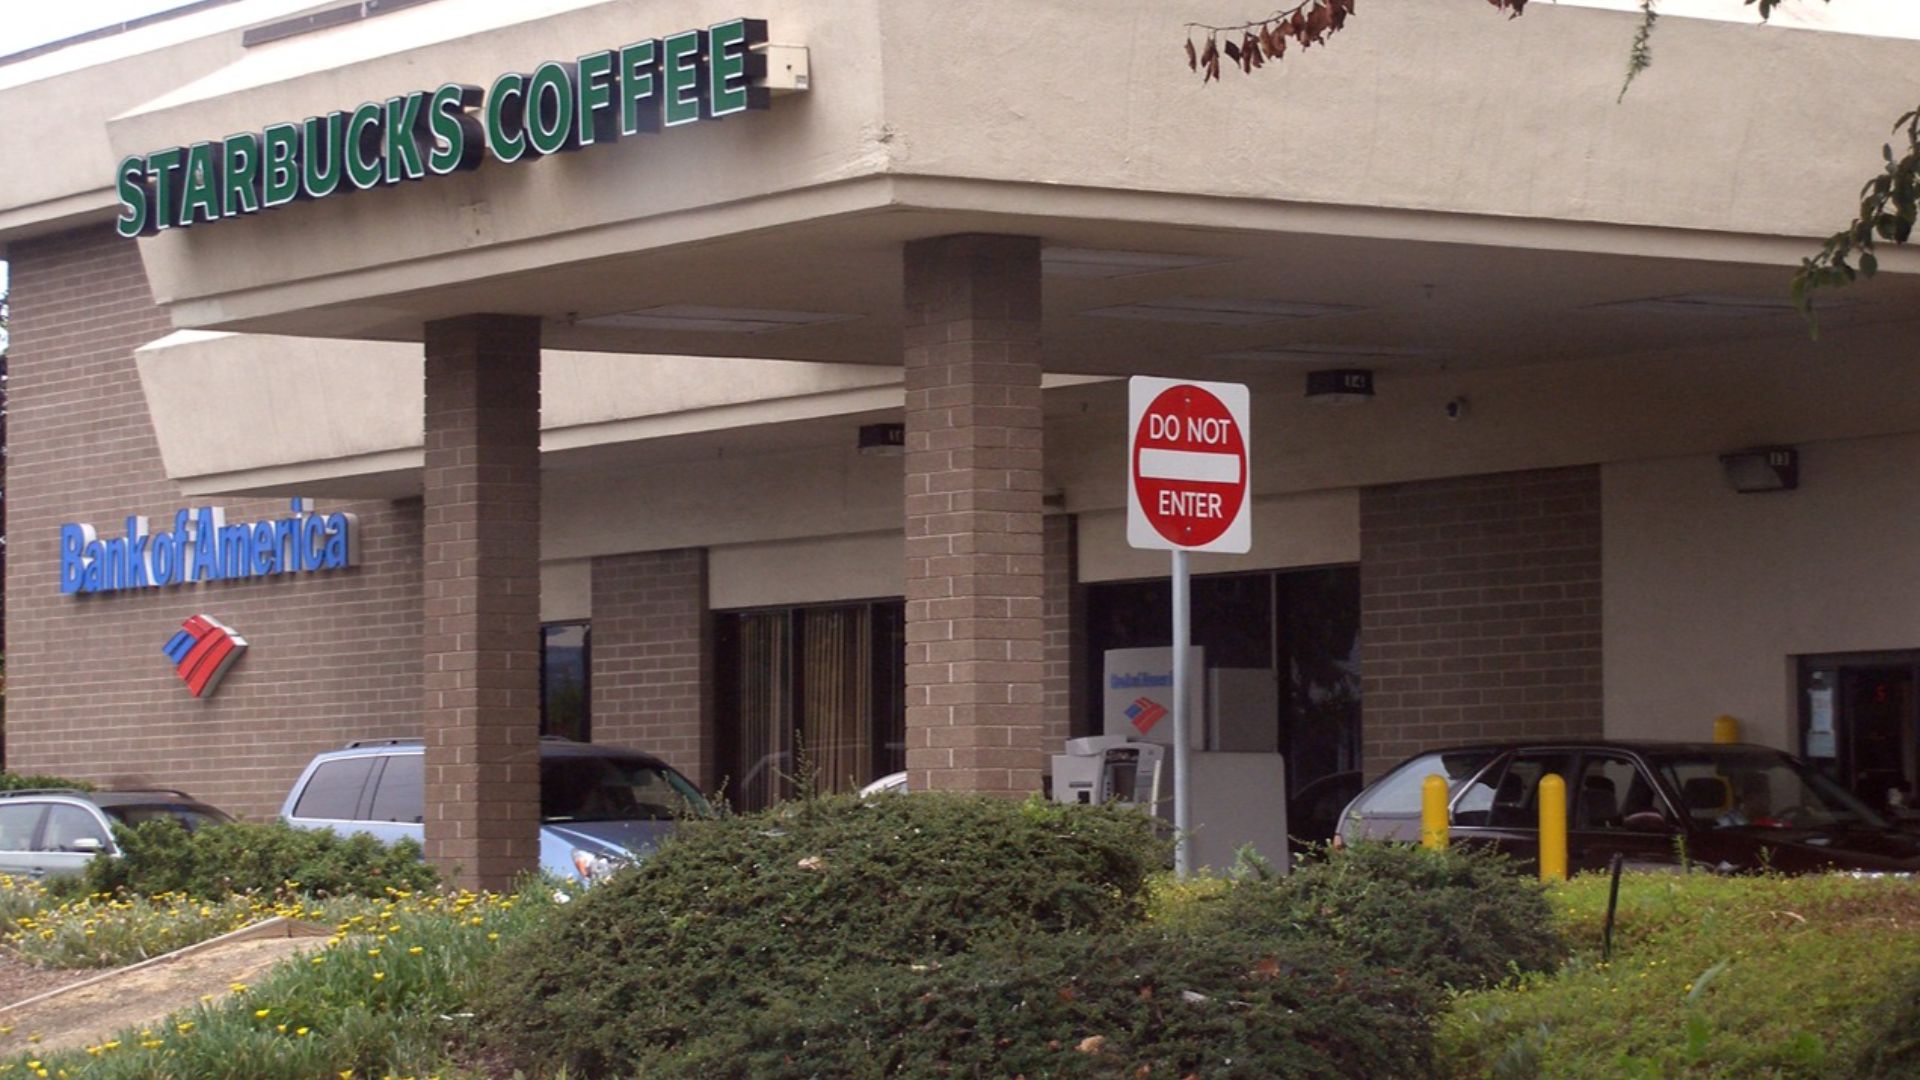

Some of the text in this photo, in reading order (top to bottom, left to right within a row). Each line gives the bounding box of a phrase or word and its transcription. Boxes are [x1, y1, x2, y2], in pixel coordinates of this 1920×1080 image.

[116, 18, 757, 239] STARBUCKS COFFEE
[1150, 413, 1231, 444] DO NOT
[1159, 489, 1223, 518] ENTER
[60, 496, 352, 594] Bank of America
